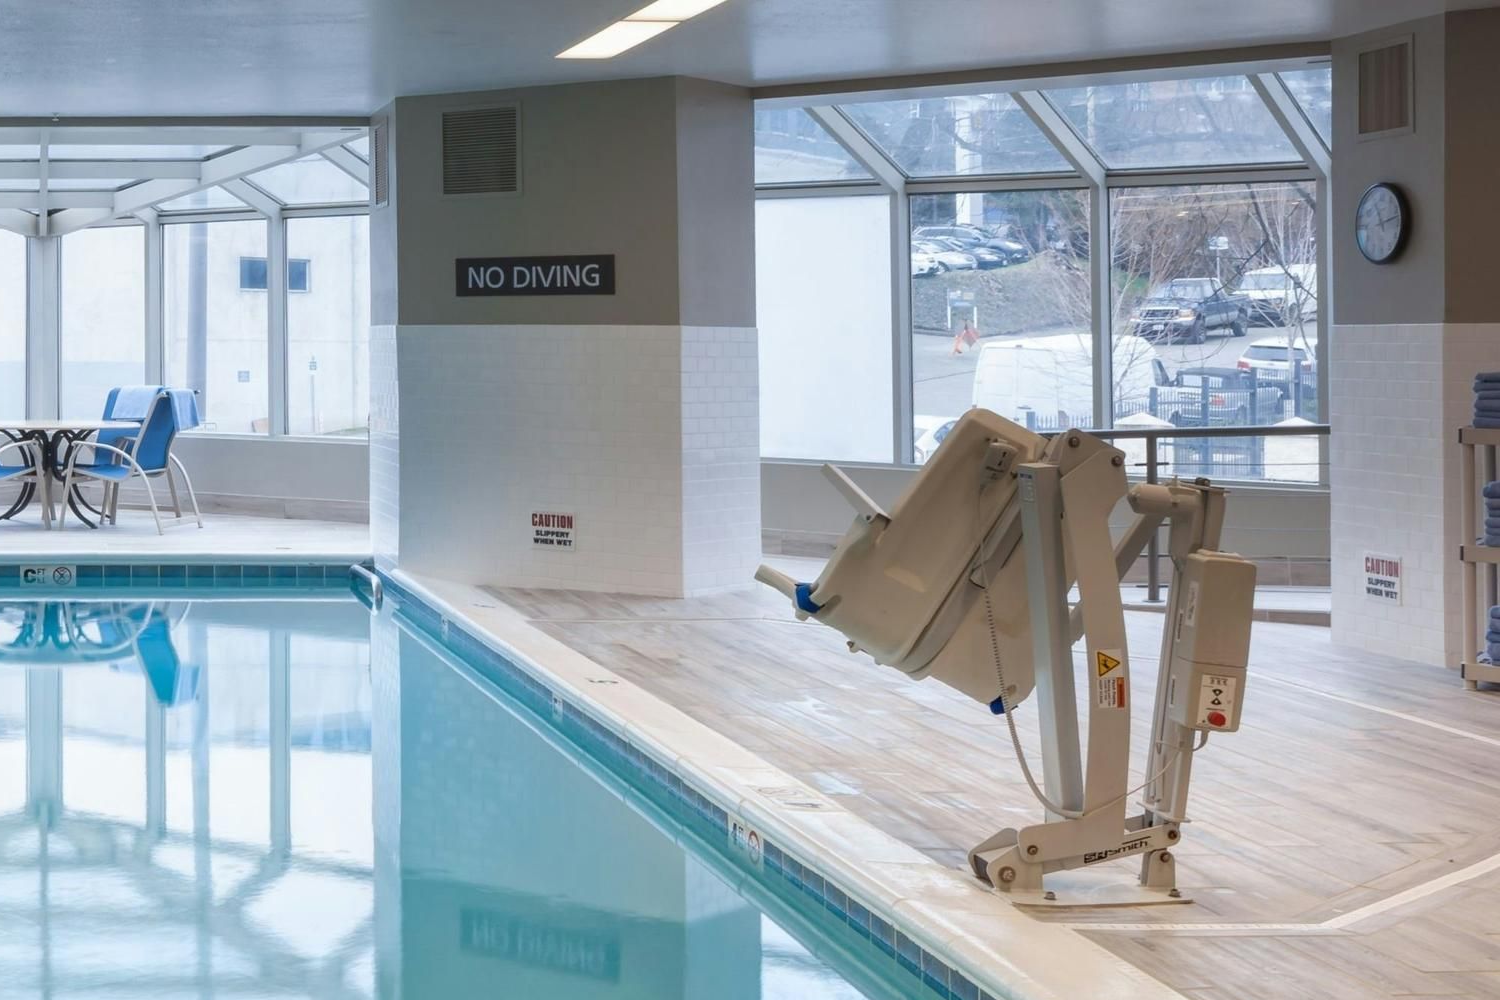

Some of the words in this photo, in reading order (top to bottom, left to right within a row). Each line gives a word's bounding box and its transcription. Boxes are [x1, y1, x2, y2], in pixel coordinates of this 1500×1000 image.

[468, 266, 504, 288] NO
[513, 264, 600, 288] DIVING
[532, 513, 573, 529] CAUTION
[535, 529, 569, 538] SLIPPERY
[533, 537, 554, 545] WHEN
[556, 538, 573, 546] WET
[1365, 556, 1399, 578] CAUTION
[1367, 577, 1396, 590] SLIPPERY
[1366, 586, 1383, 597] WHEN
[1383, 590, 1397, 600] WET
